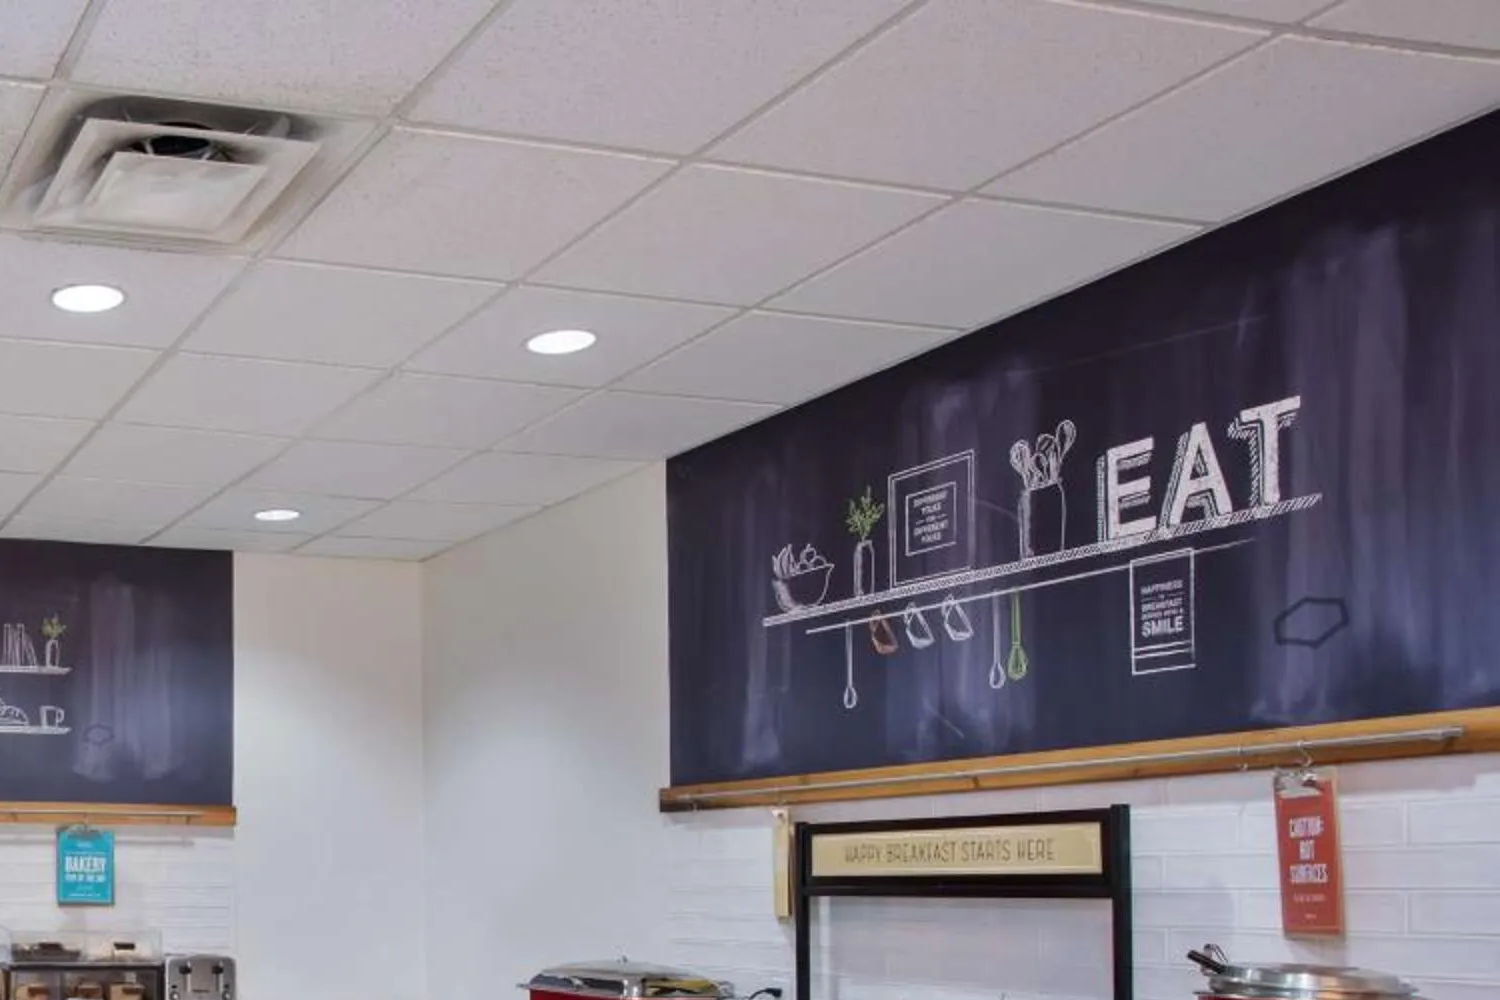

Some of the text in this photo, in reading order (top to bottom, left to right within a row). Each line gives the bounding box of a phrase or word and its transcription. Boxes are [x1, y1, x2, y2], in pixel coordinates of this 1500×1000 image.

[1097, 396, 1300, 541] EAT
[1141, 616, 1184, 638] SMILE
[845, 837, 1055, 864] HAPPY BREAKFAST STARTS HERE
[65, 855, 106, 873] BAKERY
